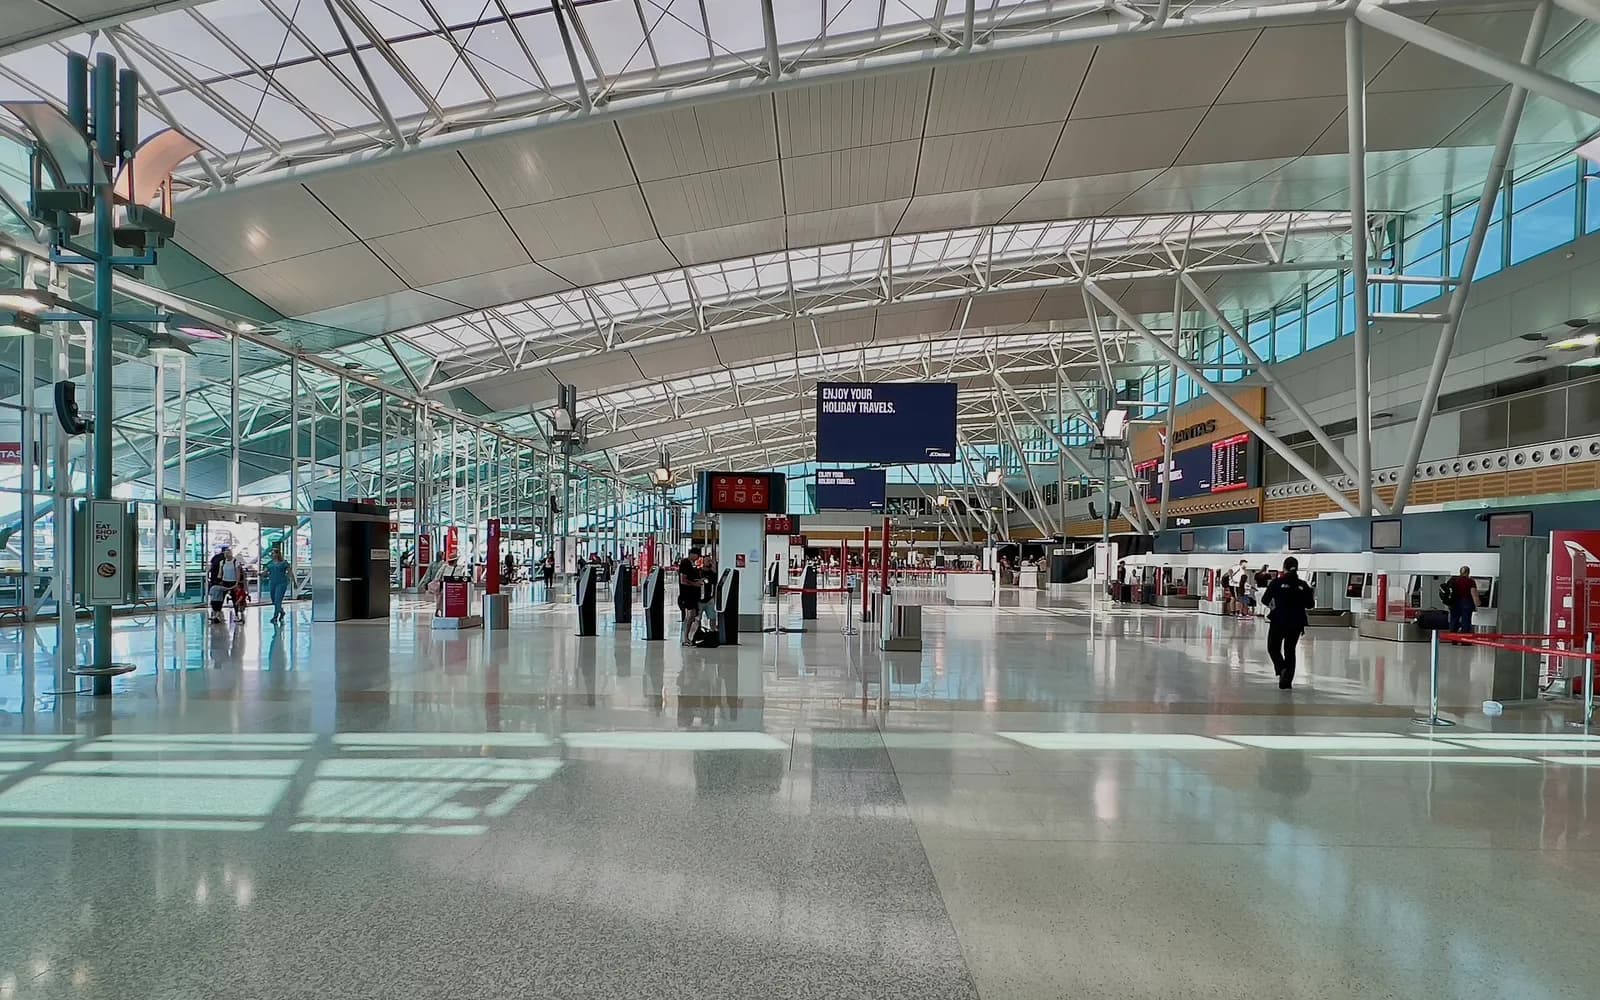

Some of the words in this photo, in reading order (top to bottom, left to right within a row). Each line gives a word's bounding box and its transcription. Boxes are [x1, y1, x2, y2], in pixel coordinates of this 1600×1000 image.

[822, 388, 849, 400] ENJOY
[850, 388, 873, 400] YOUR
[822, 401, 857, 413] HOLIDAY
[858, 402, 896, 414] TRAVELS.
